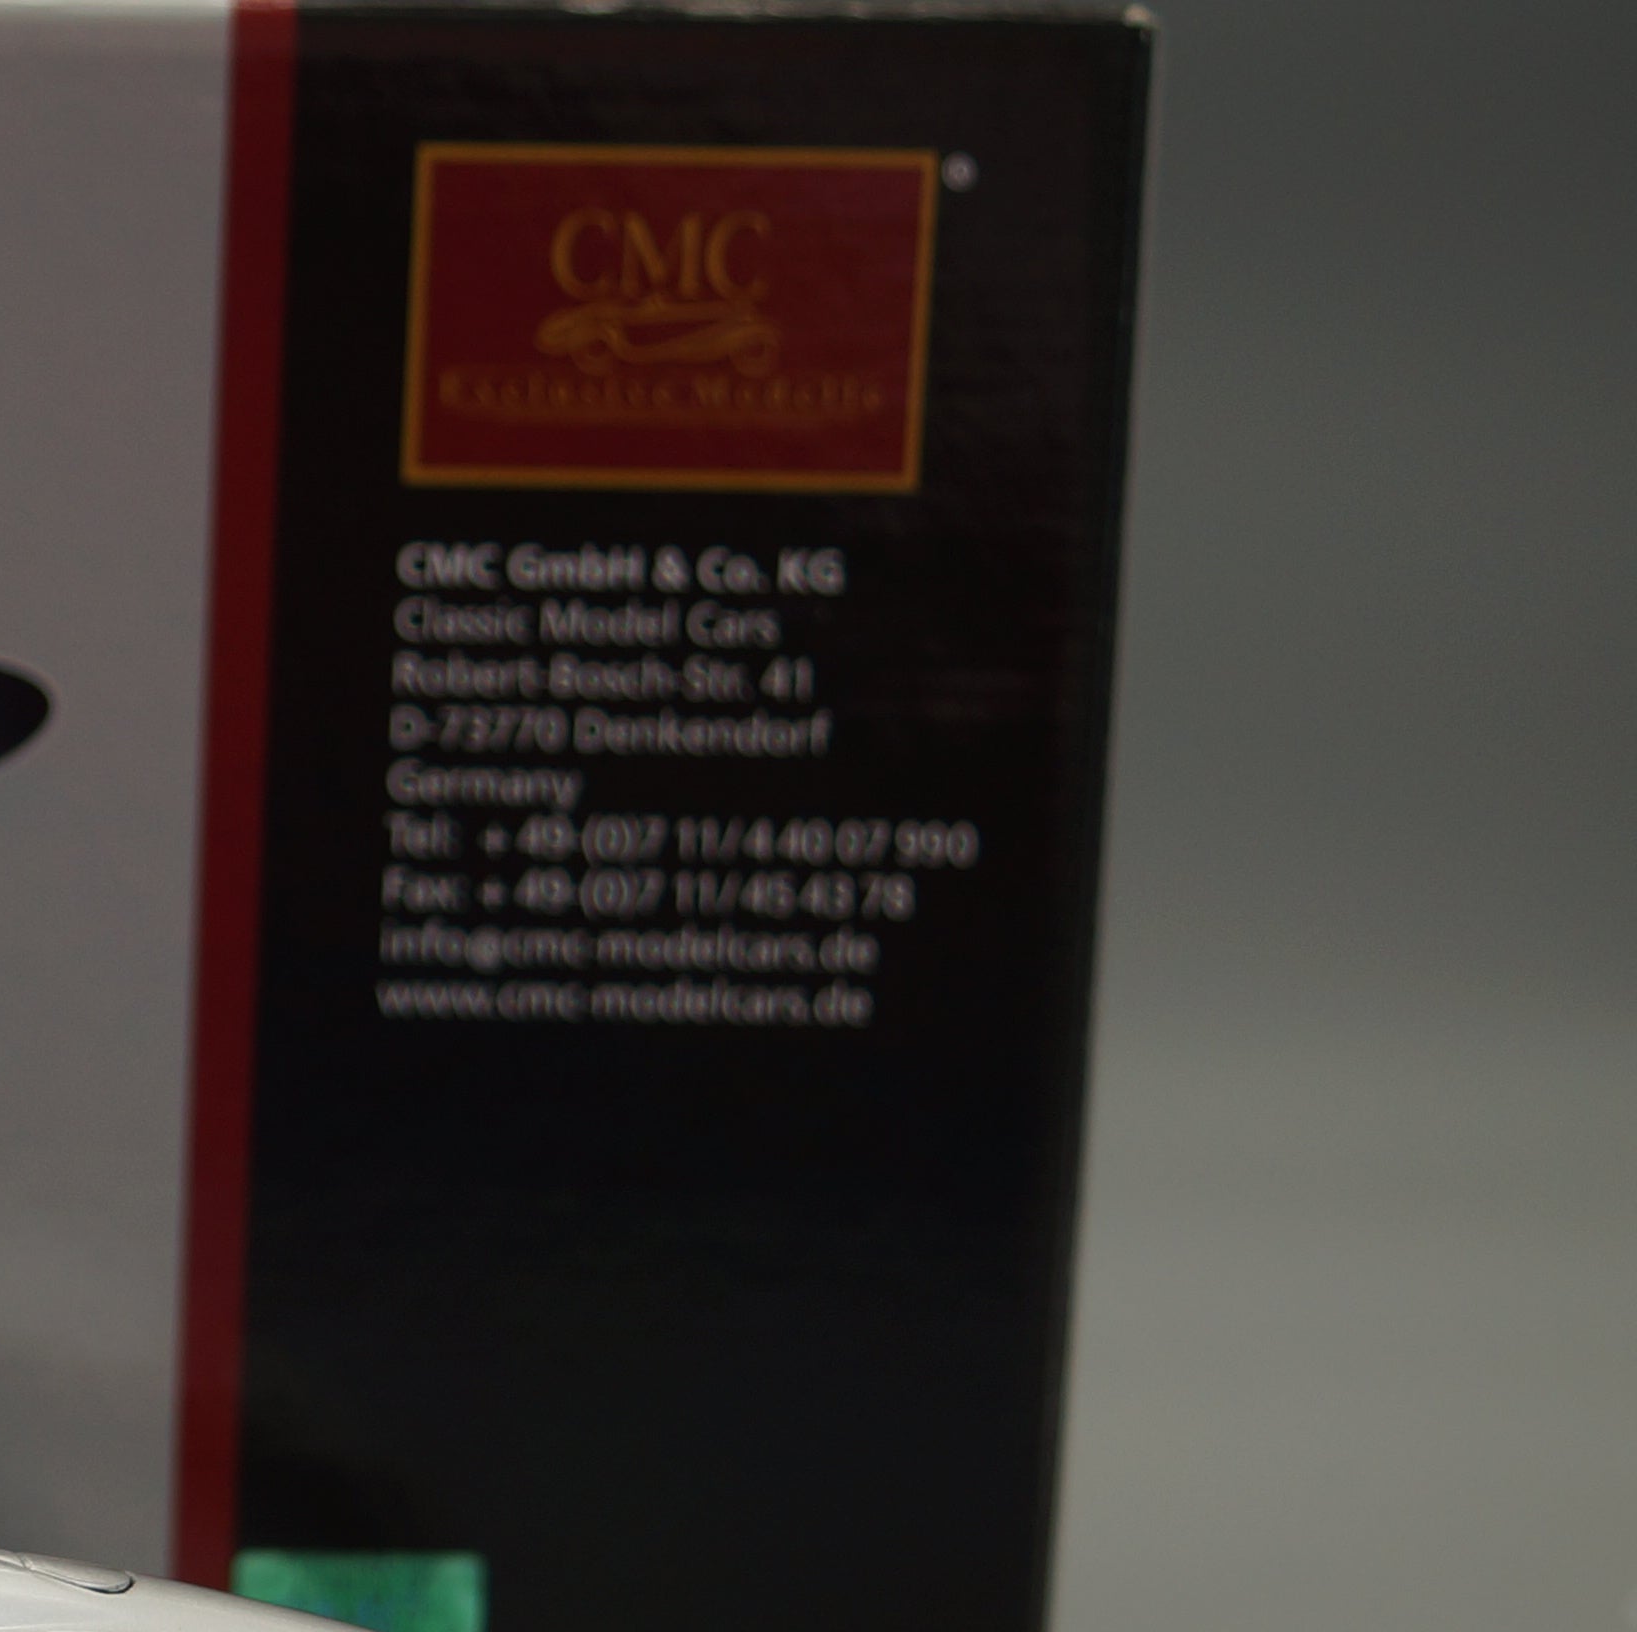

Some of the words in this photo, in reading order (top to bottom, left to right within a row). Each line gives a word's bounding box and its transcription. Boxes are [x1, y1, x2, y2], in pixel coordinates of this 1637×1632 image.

[551, 208, 771, 302] CMC
[395, 542, 502, 590] CMC
[506, 542, 646, 592] GmbH
[651, 545, 690, 594] &
[695, 545, 770, 594] Co.
[777, 547, 845, 596] KG
[393, 596, 534, 645] Classic
[539, 598, 680, 648] Model
[685, 600, 781, 649] Cars
[760, 655, 814, 700] 41
[573, 706, 832, 758] Denkendorf
[385, 757, 583, 811] Germany
